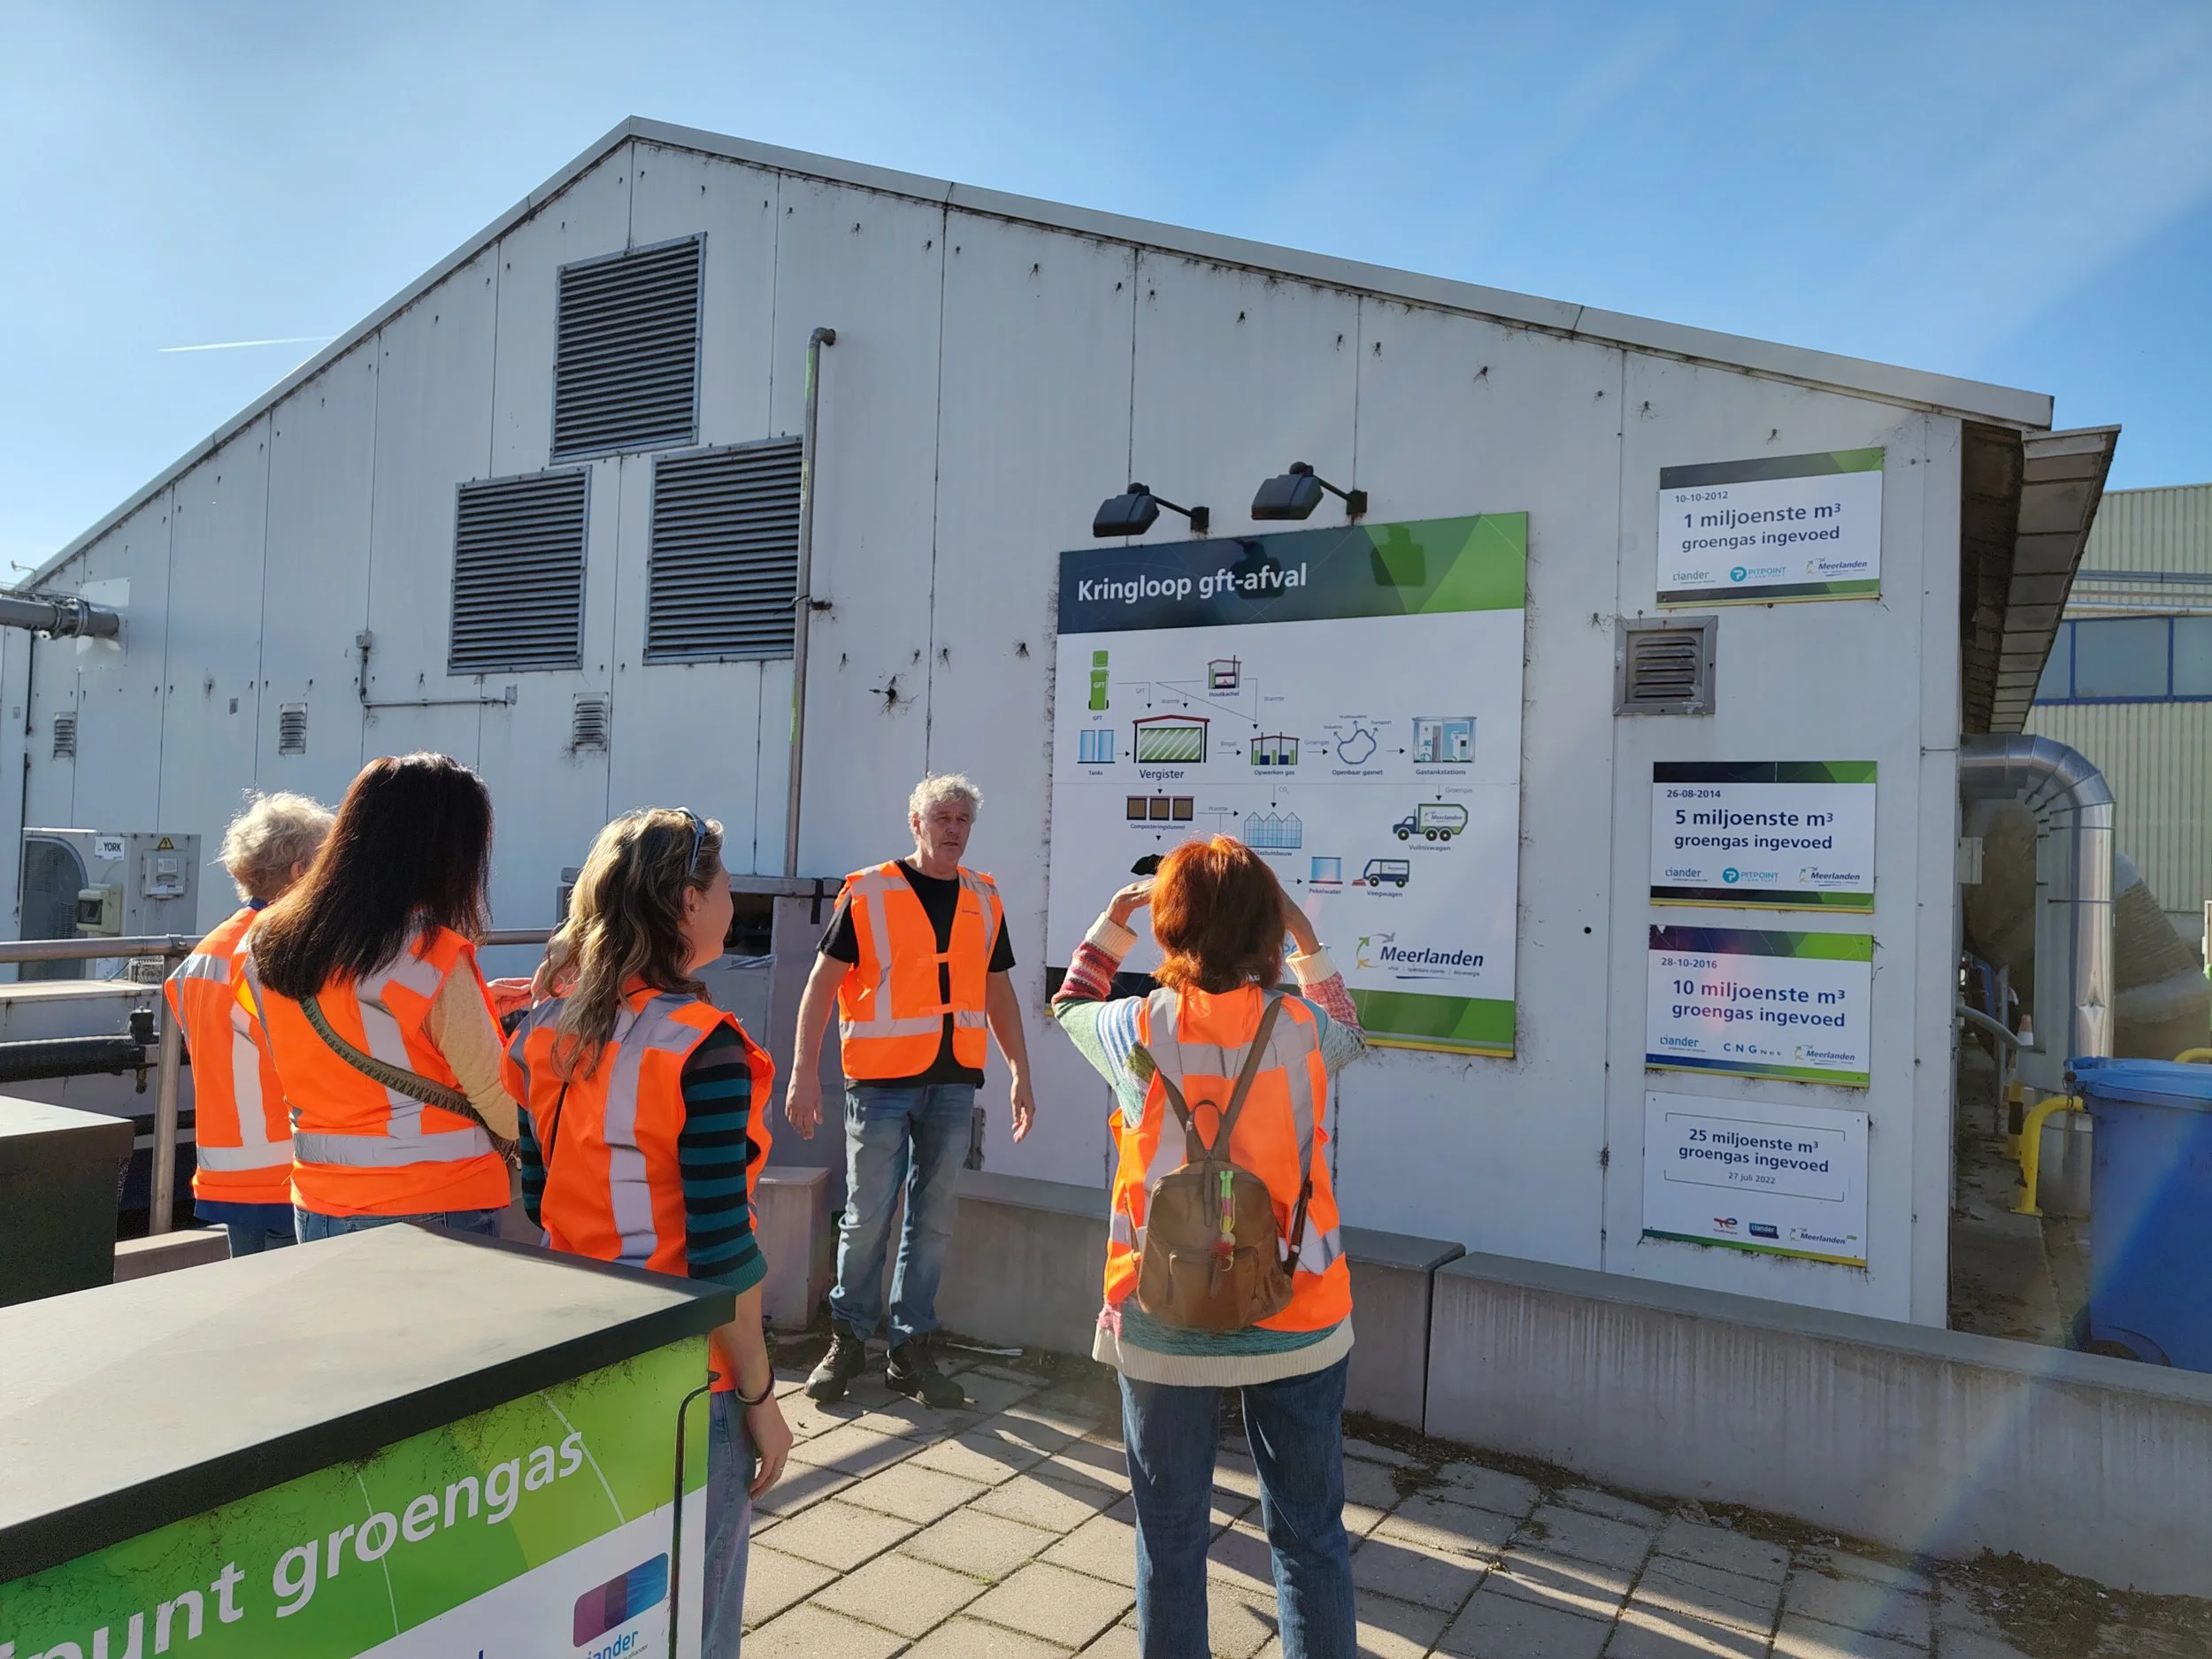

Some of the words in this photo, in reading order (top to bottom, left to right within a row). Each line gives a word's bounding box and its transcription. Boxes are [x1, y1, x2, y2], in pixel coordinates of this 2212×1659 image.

[1675, 491, 1729, 503] 10-10-2012
[1684, 513, 1693, 528] 1
[1701, 507, 1807, 529] miljoenste
[1682, 533, 1756, 552] groengas
[1762, 526, 1839, 546] ingevoed
[1818, 560, 1868, 571] Meerlanden
[1078, 575, 1192, 604] Kringloop
[1199, 563, 1307, 599] gft-afval
[1139, 769, 1185, 780] Vergister
[1666, 789, 1721, 798] 26-08-2014
[1675, 810, 1686, 825] 5
[1693, 809, 1799, 829] miljoenste
[104, 841, 122, 851] YORK
[1674, 834, 1748, 849] groengas
[1755, 834, 1832, 850] ingevoed
[1811, 872, 1860, 880] Meerlanden
[1379, 945, 1484, 968] Meerlanden
[1661, 956, 1717, 969] 28-10-2016
[1672, 979, 1694, 995] 10
[1701, 981, 1809, 1003] miljoenste
[1671, 1004, 1754, 1022] groengas
[1760, 1007, 1845, 1027] ingevoed
[1806, 1049, 1855, 1061] Meerlanden
[1688, 1128, 1707, 1141] 25
[1712, 1132, 1793, 1152] miljoenste
[1678, 1146, 1749, 1164] groengas
[1755, 1152, 1829, 1173] ingevoed
[1728, 1171, 1739, 1180] 27
[1740, 1172, 1753, 1183] juli
[1755, 1174, 1776, 1184] 2022
[1801, 1233, 1846, 1245] Meerlanden
[0, 1562, 246, 1659] unt
[273, 1430, 583, 1617] groengas
